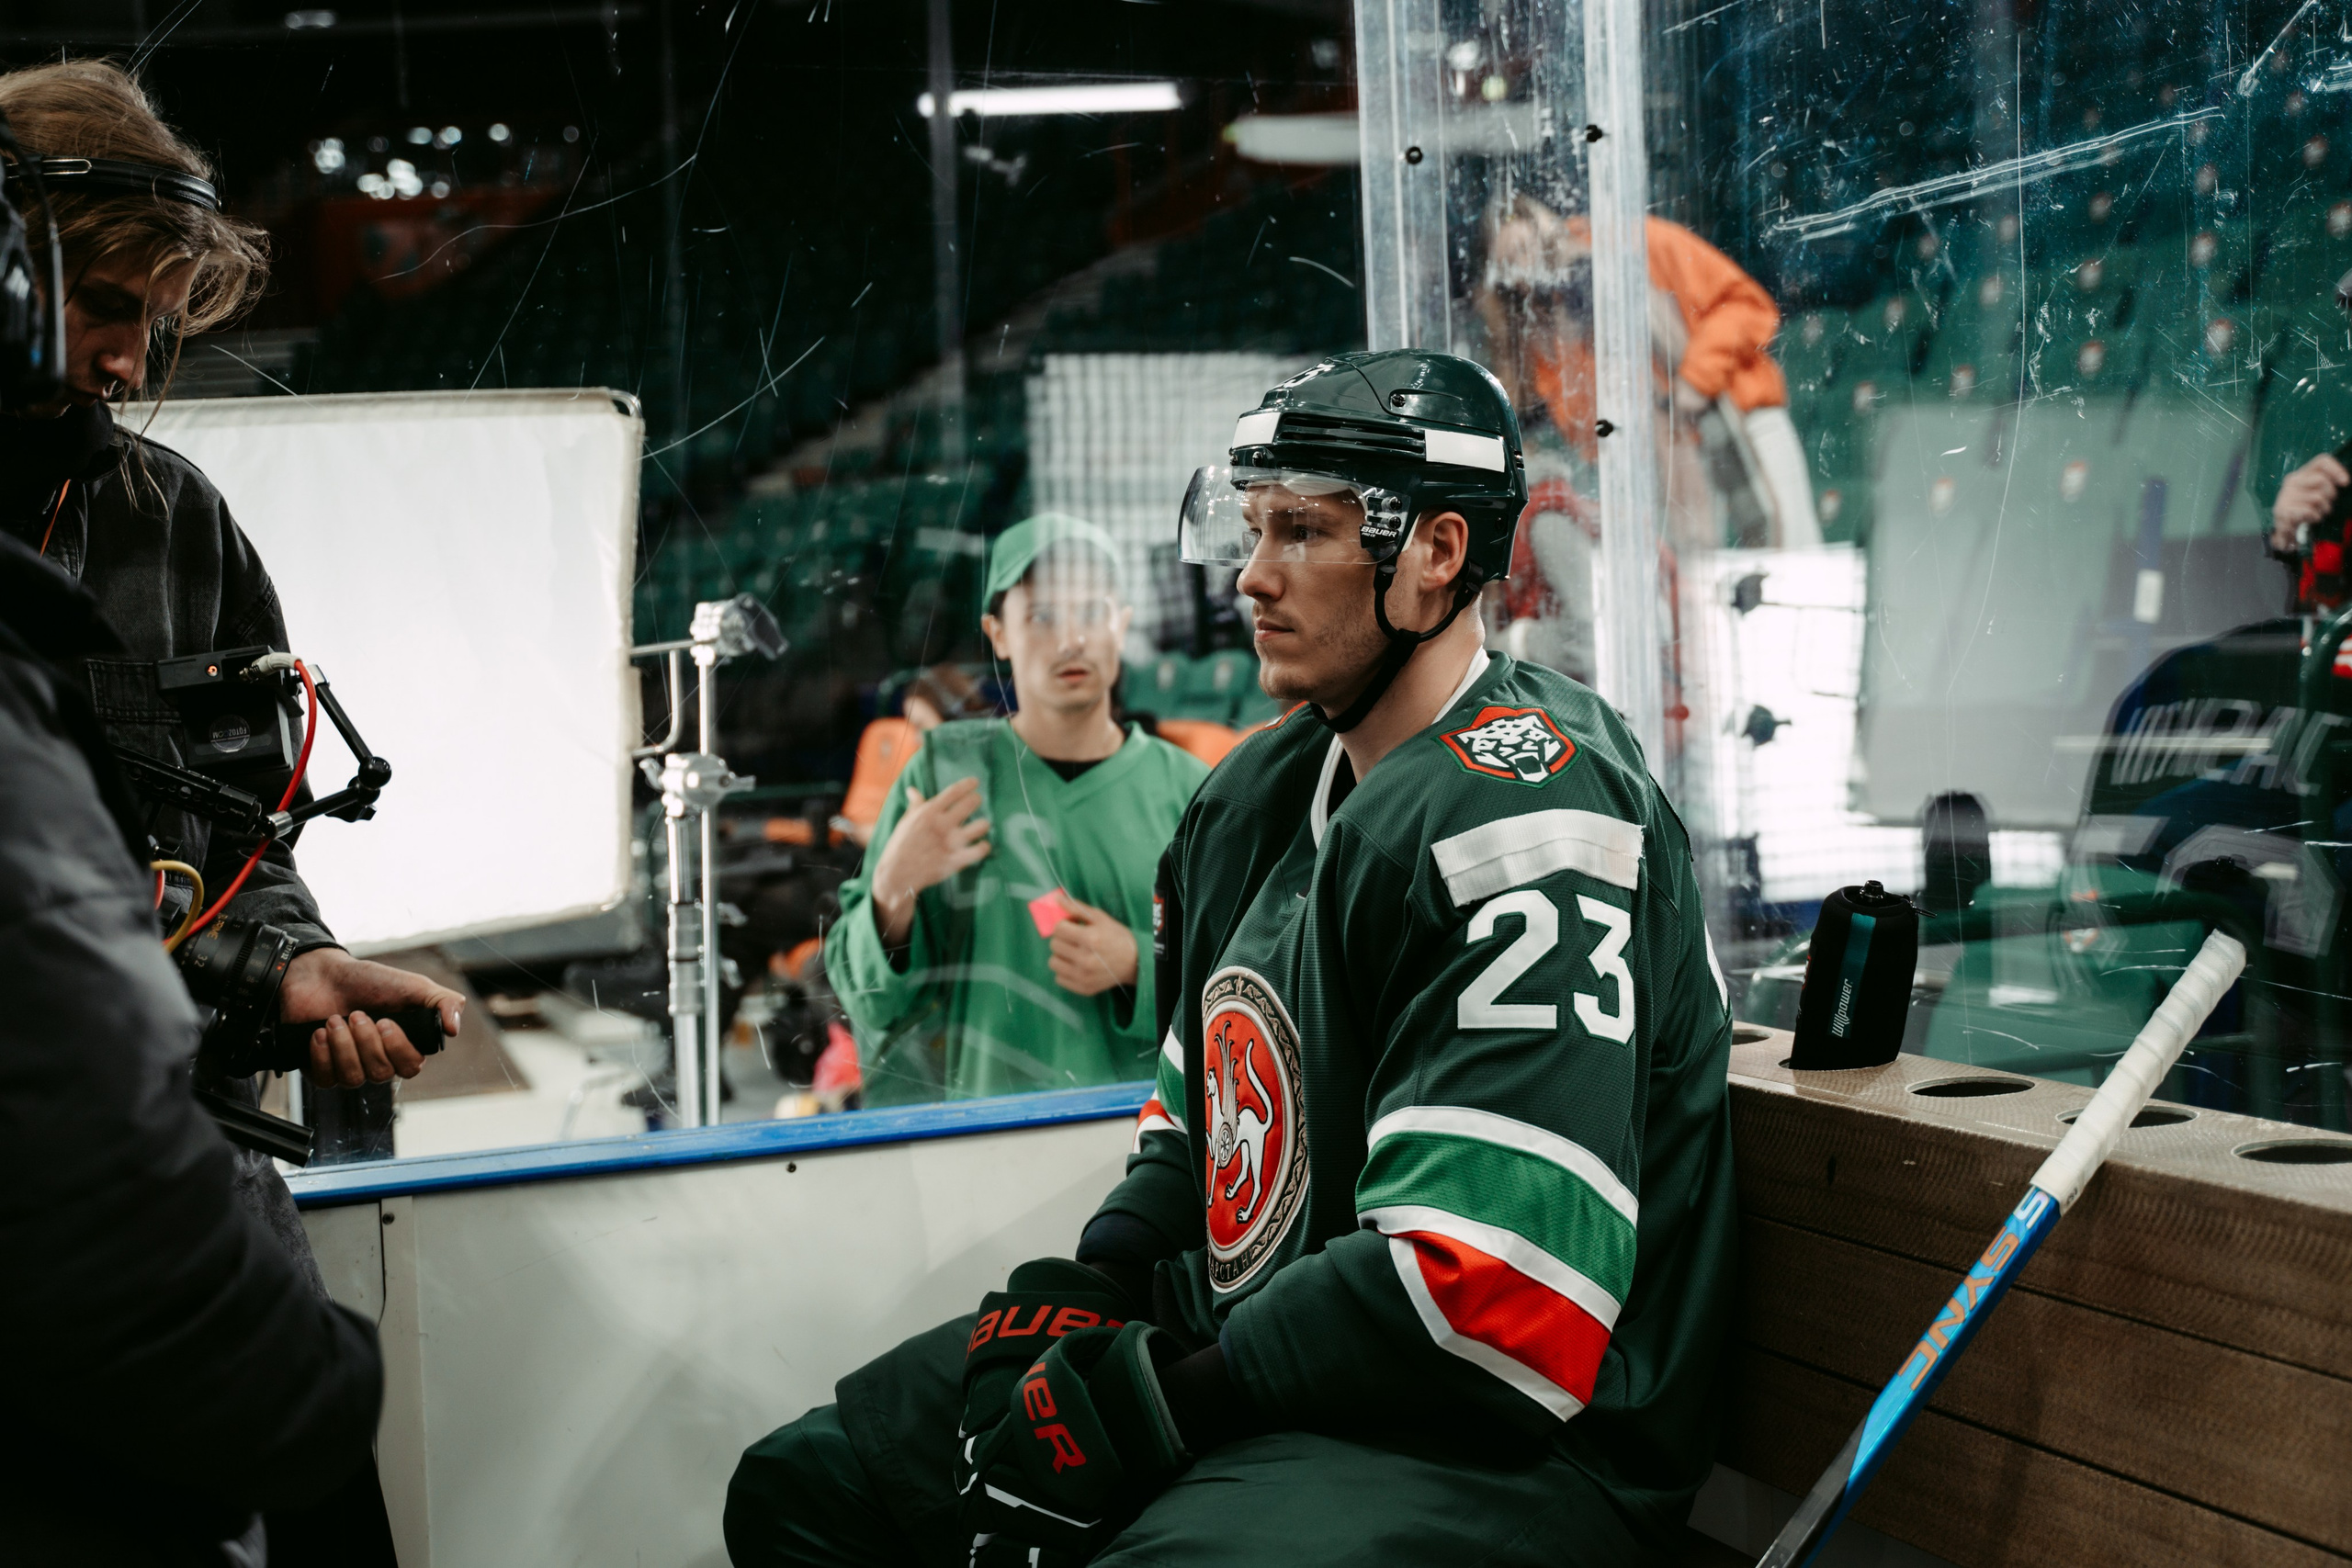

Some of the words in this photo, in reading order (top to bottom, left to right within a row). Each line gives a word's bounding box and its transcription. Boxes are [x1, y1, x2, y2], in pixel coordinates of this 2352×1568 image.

[194, 953, 208, 968] 32
[1457, 889, 1634, 1044] 23
[1831, 977, 1853, 1037] Willpower
[966, 1304, 1125, 1360] AUE
[1897, 1225, 2019, 1391] SYNC
